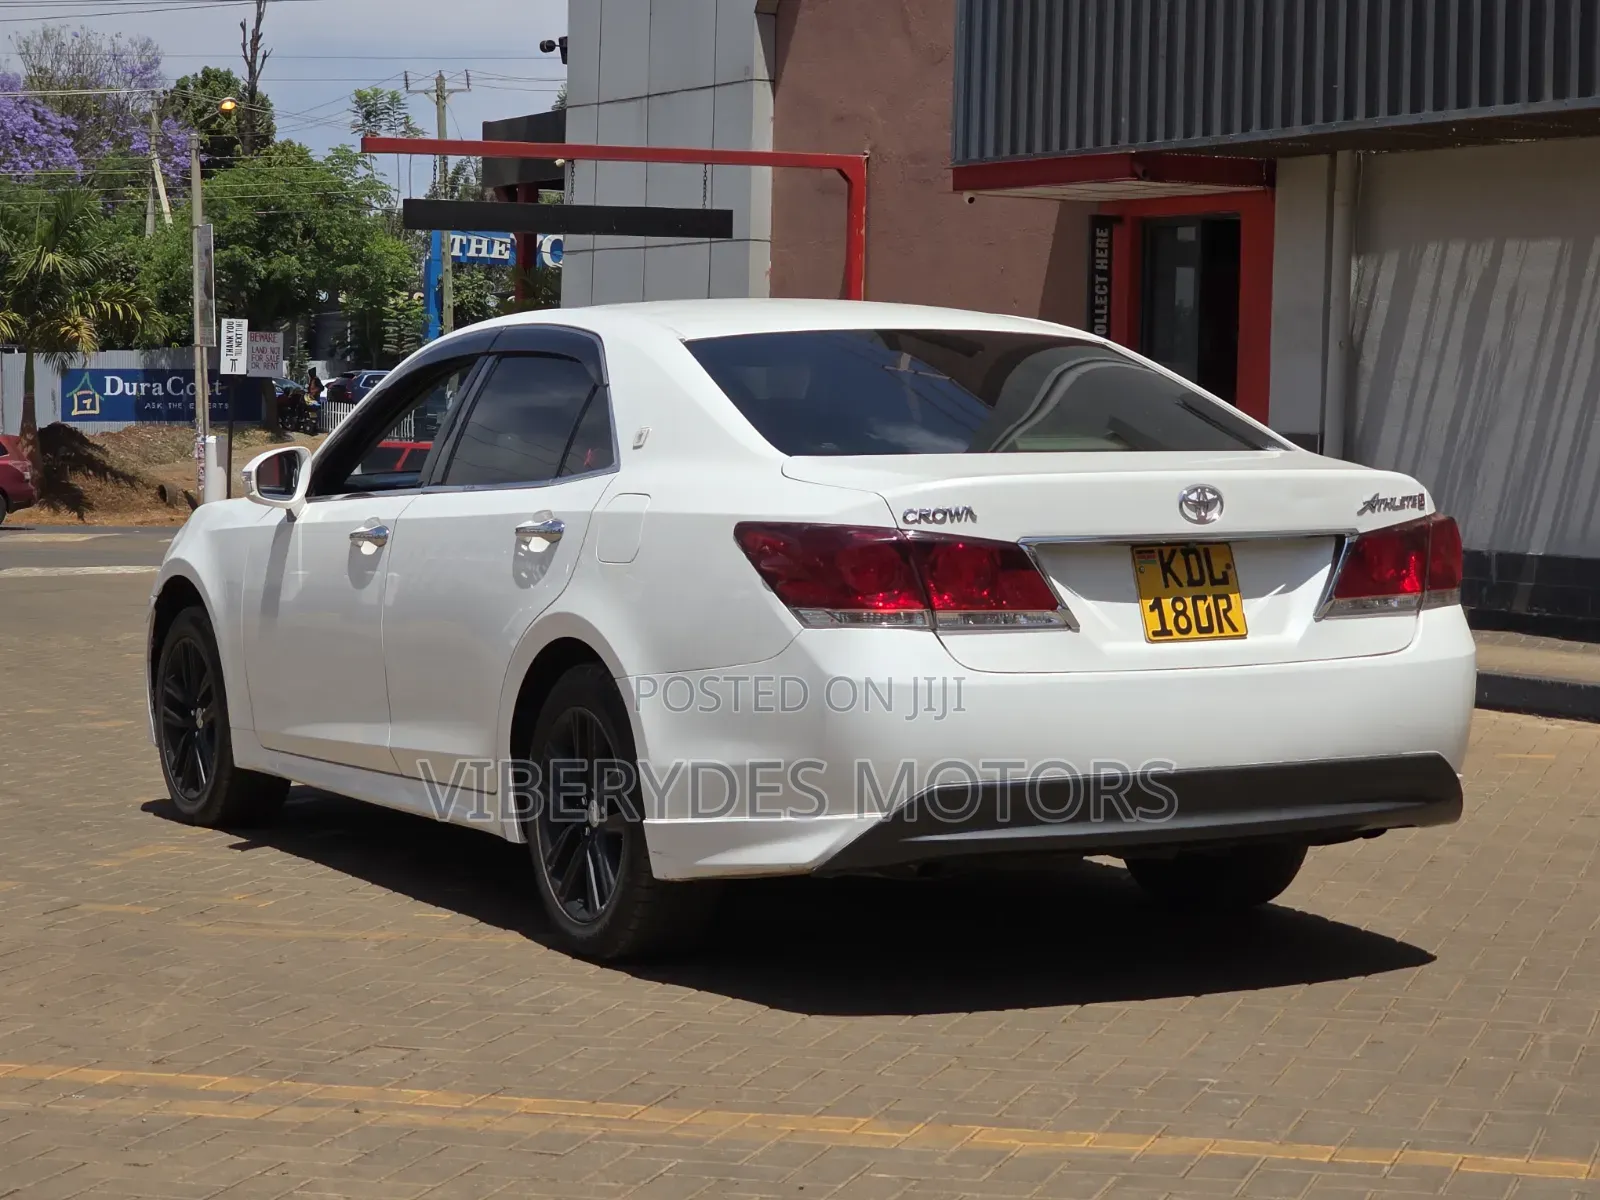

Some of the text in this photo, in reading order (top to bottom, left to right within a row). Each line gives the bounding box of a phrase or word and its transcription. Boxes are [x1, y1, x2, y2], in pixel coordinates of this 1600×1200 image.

[450, 234, 511, 259] THE
[1094, 227, 1108, 336] OLLECT HERE
[235, 320, 244, 332] TIME
[225, 320, 235, 357] THANK YOU
[235, 333, 243, 348] NEXT
[250, 332, 279, 343] BEWARE
[251, 354, 280, 362] FOR SALE
[252, 346, 281, 355] LAND NOT
[251, 362, 279, 370] OR RENT
[103, 375, 223, 396] DuraCot
[144, 402, 230, 410] ASK THE EERTS
[902, 505, 978, 525] CROWN
[1158, 547, 1230, 588] KDL
[1149, 593, 1239, 637] 180R
